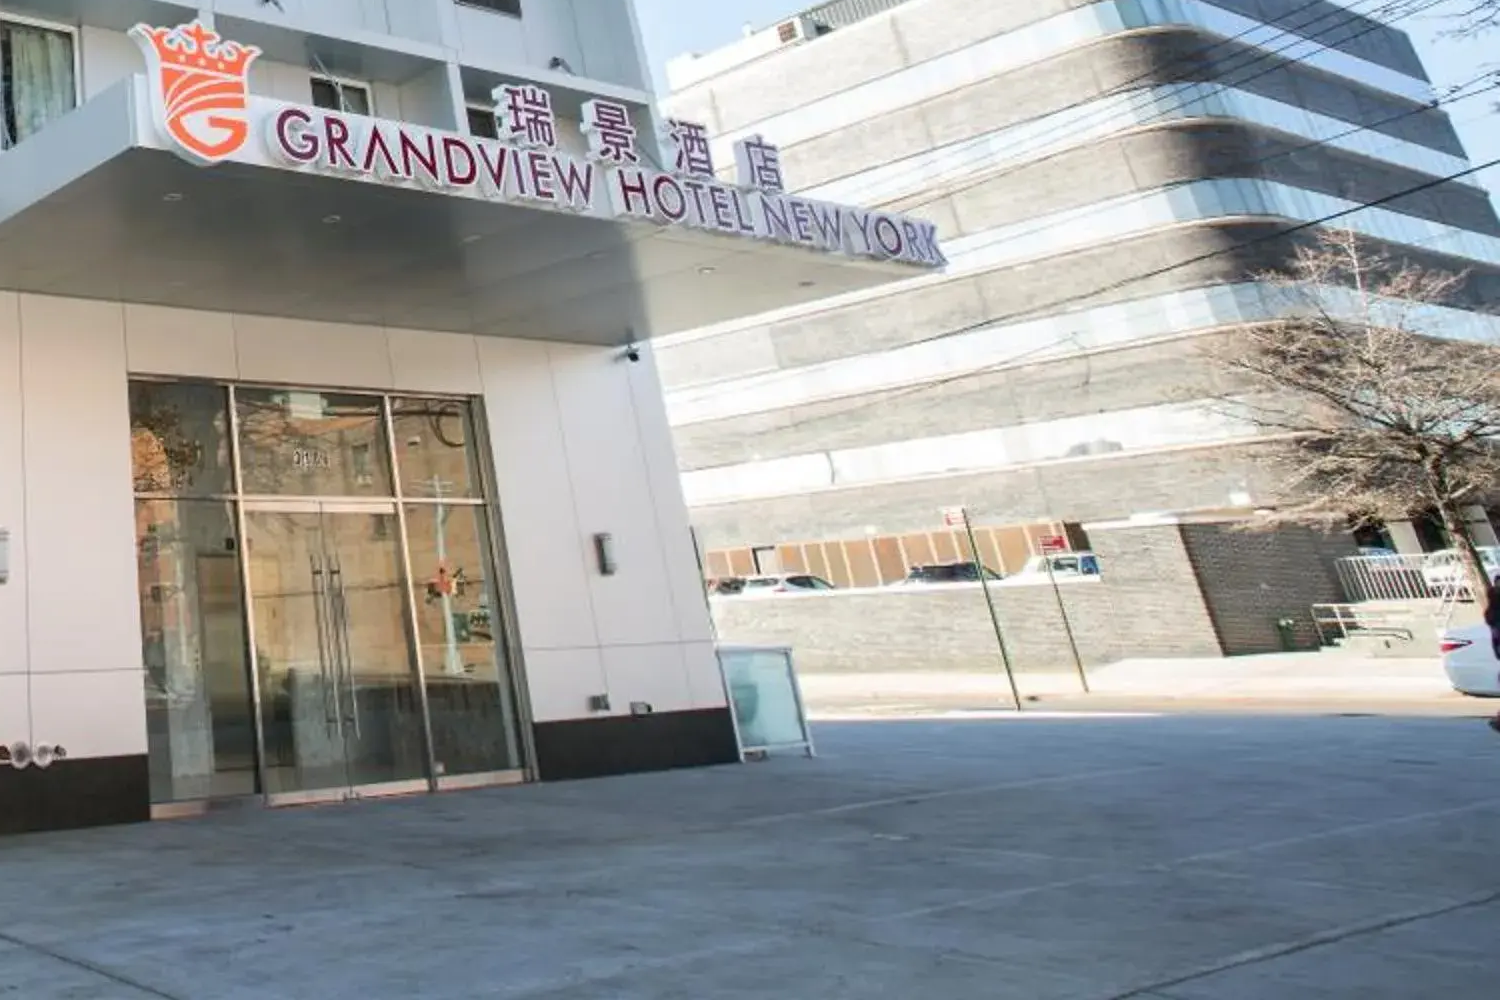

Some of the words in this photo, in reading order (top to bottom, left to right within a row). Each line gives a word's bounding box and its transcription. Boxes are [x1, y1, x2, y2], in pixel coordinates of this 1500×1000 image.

[276, 108, 594, 205] GRANDVIEW
[617, 168, 754, 232] HOTEL
[759, 194, 842, 245] NEW
[850, 209, 948, 265] YORK
[504, 87, 784, 191] 瑞景酒店
